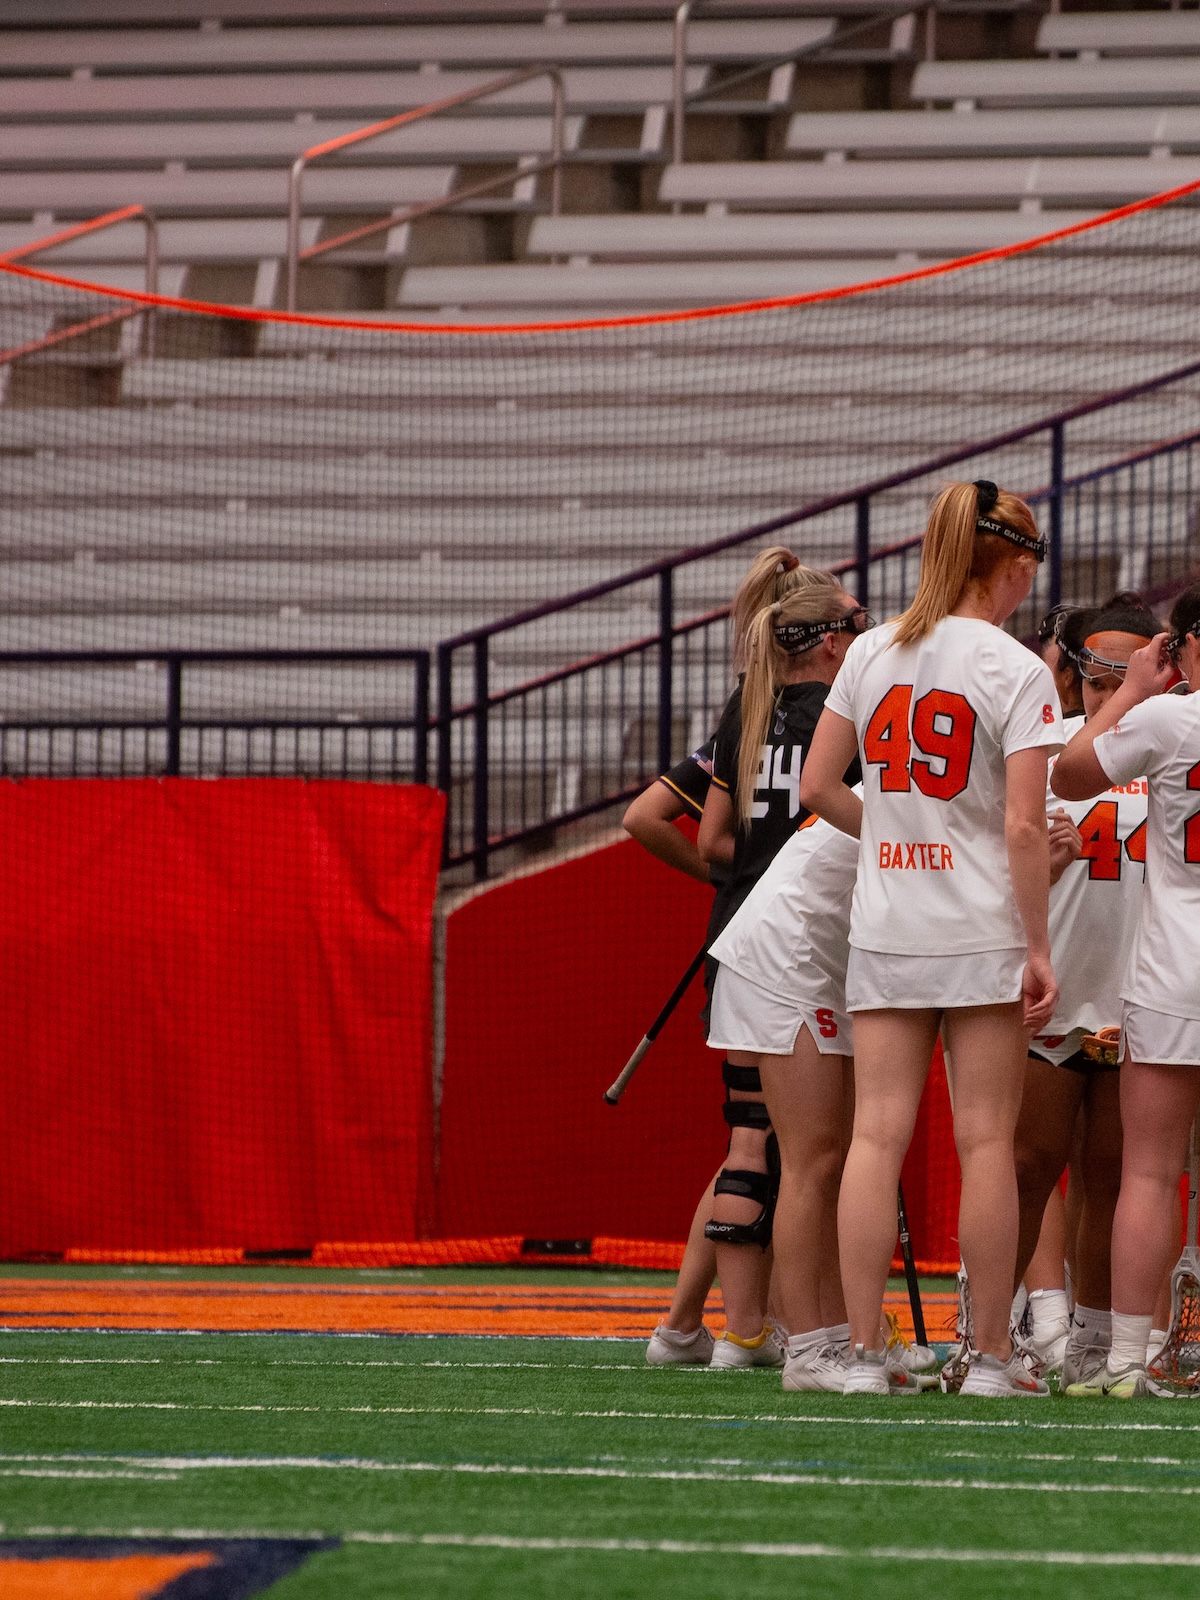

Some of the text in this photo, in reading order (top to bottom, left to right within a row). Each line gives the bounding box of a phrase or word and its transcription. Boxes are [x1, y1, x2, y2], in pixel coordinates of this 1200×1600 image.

[978, 520, 1001, 531] GAIT
[1042, 704, 1054, 724] S
[864, 684, 976, 801] 49
[879, 842, 954, 870] BAXTER
[816, 1009, 839, 1038] S
